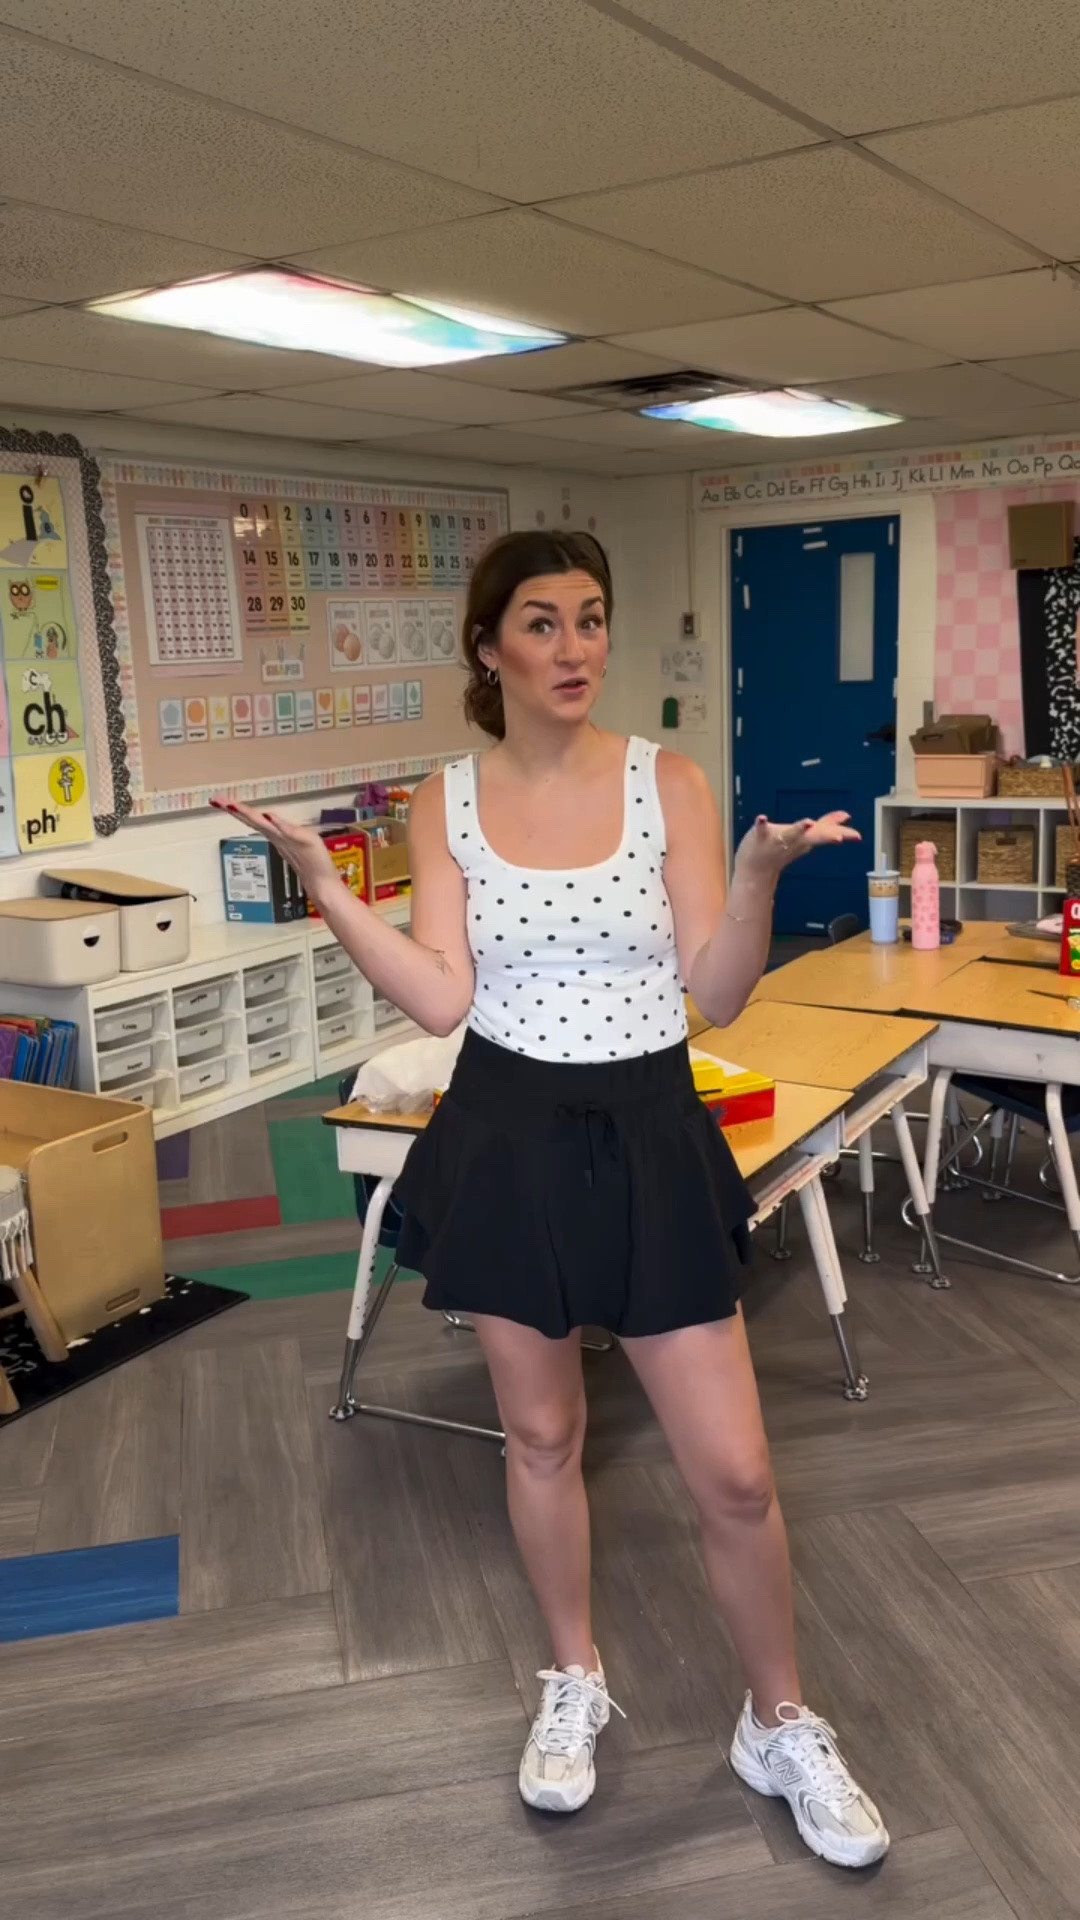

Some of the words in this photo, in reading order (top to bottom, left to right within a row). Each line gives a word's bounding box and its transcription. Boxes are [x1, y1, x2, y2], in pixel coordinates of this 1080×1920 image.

[701, 489, 720, 502] Aa
[724, 486, 741, 501] Bb
[744, 484, 762, 499] Cc
[767, 481, 785, 497] Dd
[789, 480, 805, 495] Ee
[810, 478, 825, 493] Ff
[828, 476, 849, 496] Gg
[853, 473, 871, 489] Hh
[875, 472, 886, 488] Ii
[891, 470, 904, 492] Jj
[908, 468, 926, 484] Kk
[929, 466, 943, 482] Ll
[950, 464, 975, 480] Mm
[982, 462, 1002, 477] Nn
[1007, 459, 1029, 475] Oo
[1033, 456, 1054, 478] Pp
[19, 484, 38, 541] i
[239, 503, 248, 518] 0
[263, 504, 269, 520] 1
[284, 506, 292, 521] 2
[305, 507, 312, 521] 3
[325, 508, 332, 522] 4
[344, 509, 351, 523] 5
[363, 510, 370, 524] 6
[381, 511, 387, 525] 7
[399, 513, 405, 527] 8
[416, 513, 422, 527] 9
[430, 514, 440, 528] 10
[447, 515, 455, 529] 11
[462, 517, 471, 530] 12
[477, 518, 486, 531] 13
[243, 550, 256, 565] 14
[265, 551, 278, 566] 15
[287, 551, 299, 566] 16
[308, 552, 319, 566] 17
[328, 552, 340, 567] 18
[347, 553, 358, 567] 19
[365, 553, 378, 567] 20
[384, 553, 394, 567] 21
[401, 554, 413, 568] 22
[417, 554, 429, 568] 23
[434, 555, 445, 568] 24
[450, 556, 459, 569] 25
[247, 597, 263, 612] 28
[270, 597, 284, 611] 29
[291, 596, 305, 611] 30
[24, 691, 66, 736] ch
[26, 808, 57, 845] ph
